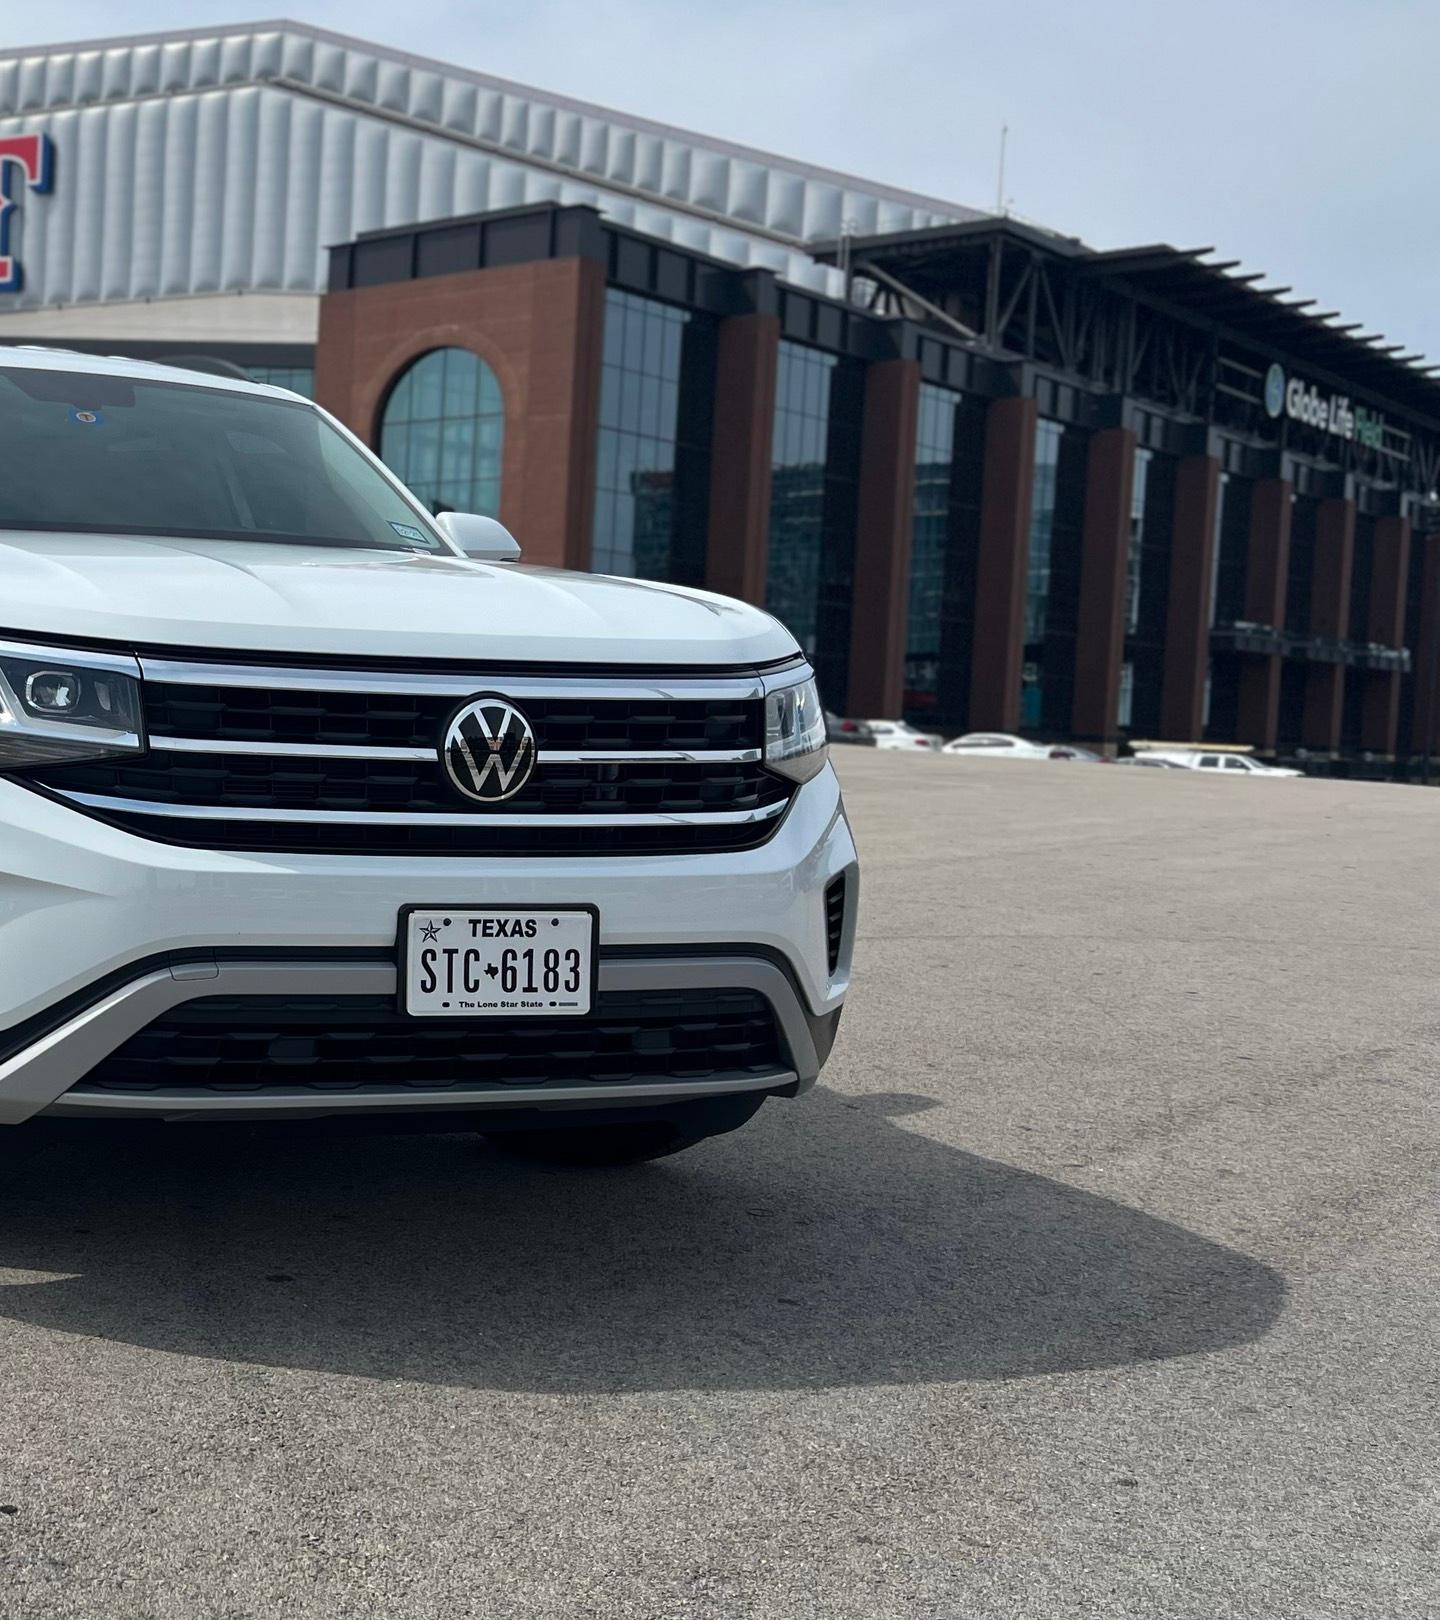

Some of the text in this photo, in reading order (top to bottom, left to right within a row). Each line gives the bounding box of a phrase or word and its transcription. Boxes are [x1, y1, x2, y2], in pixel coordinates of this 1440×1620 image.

[1287, 378, 1384, 448] Globe Life Field
[468, 918, 537, 938] TEXAS
[420, 948, 580, 994] STC 6183
